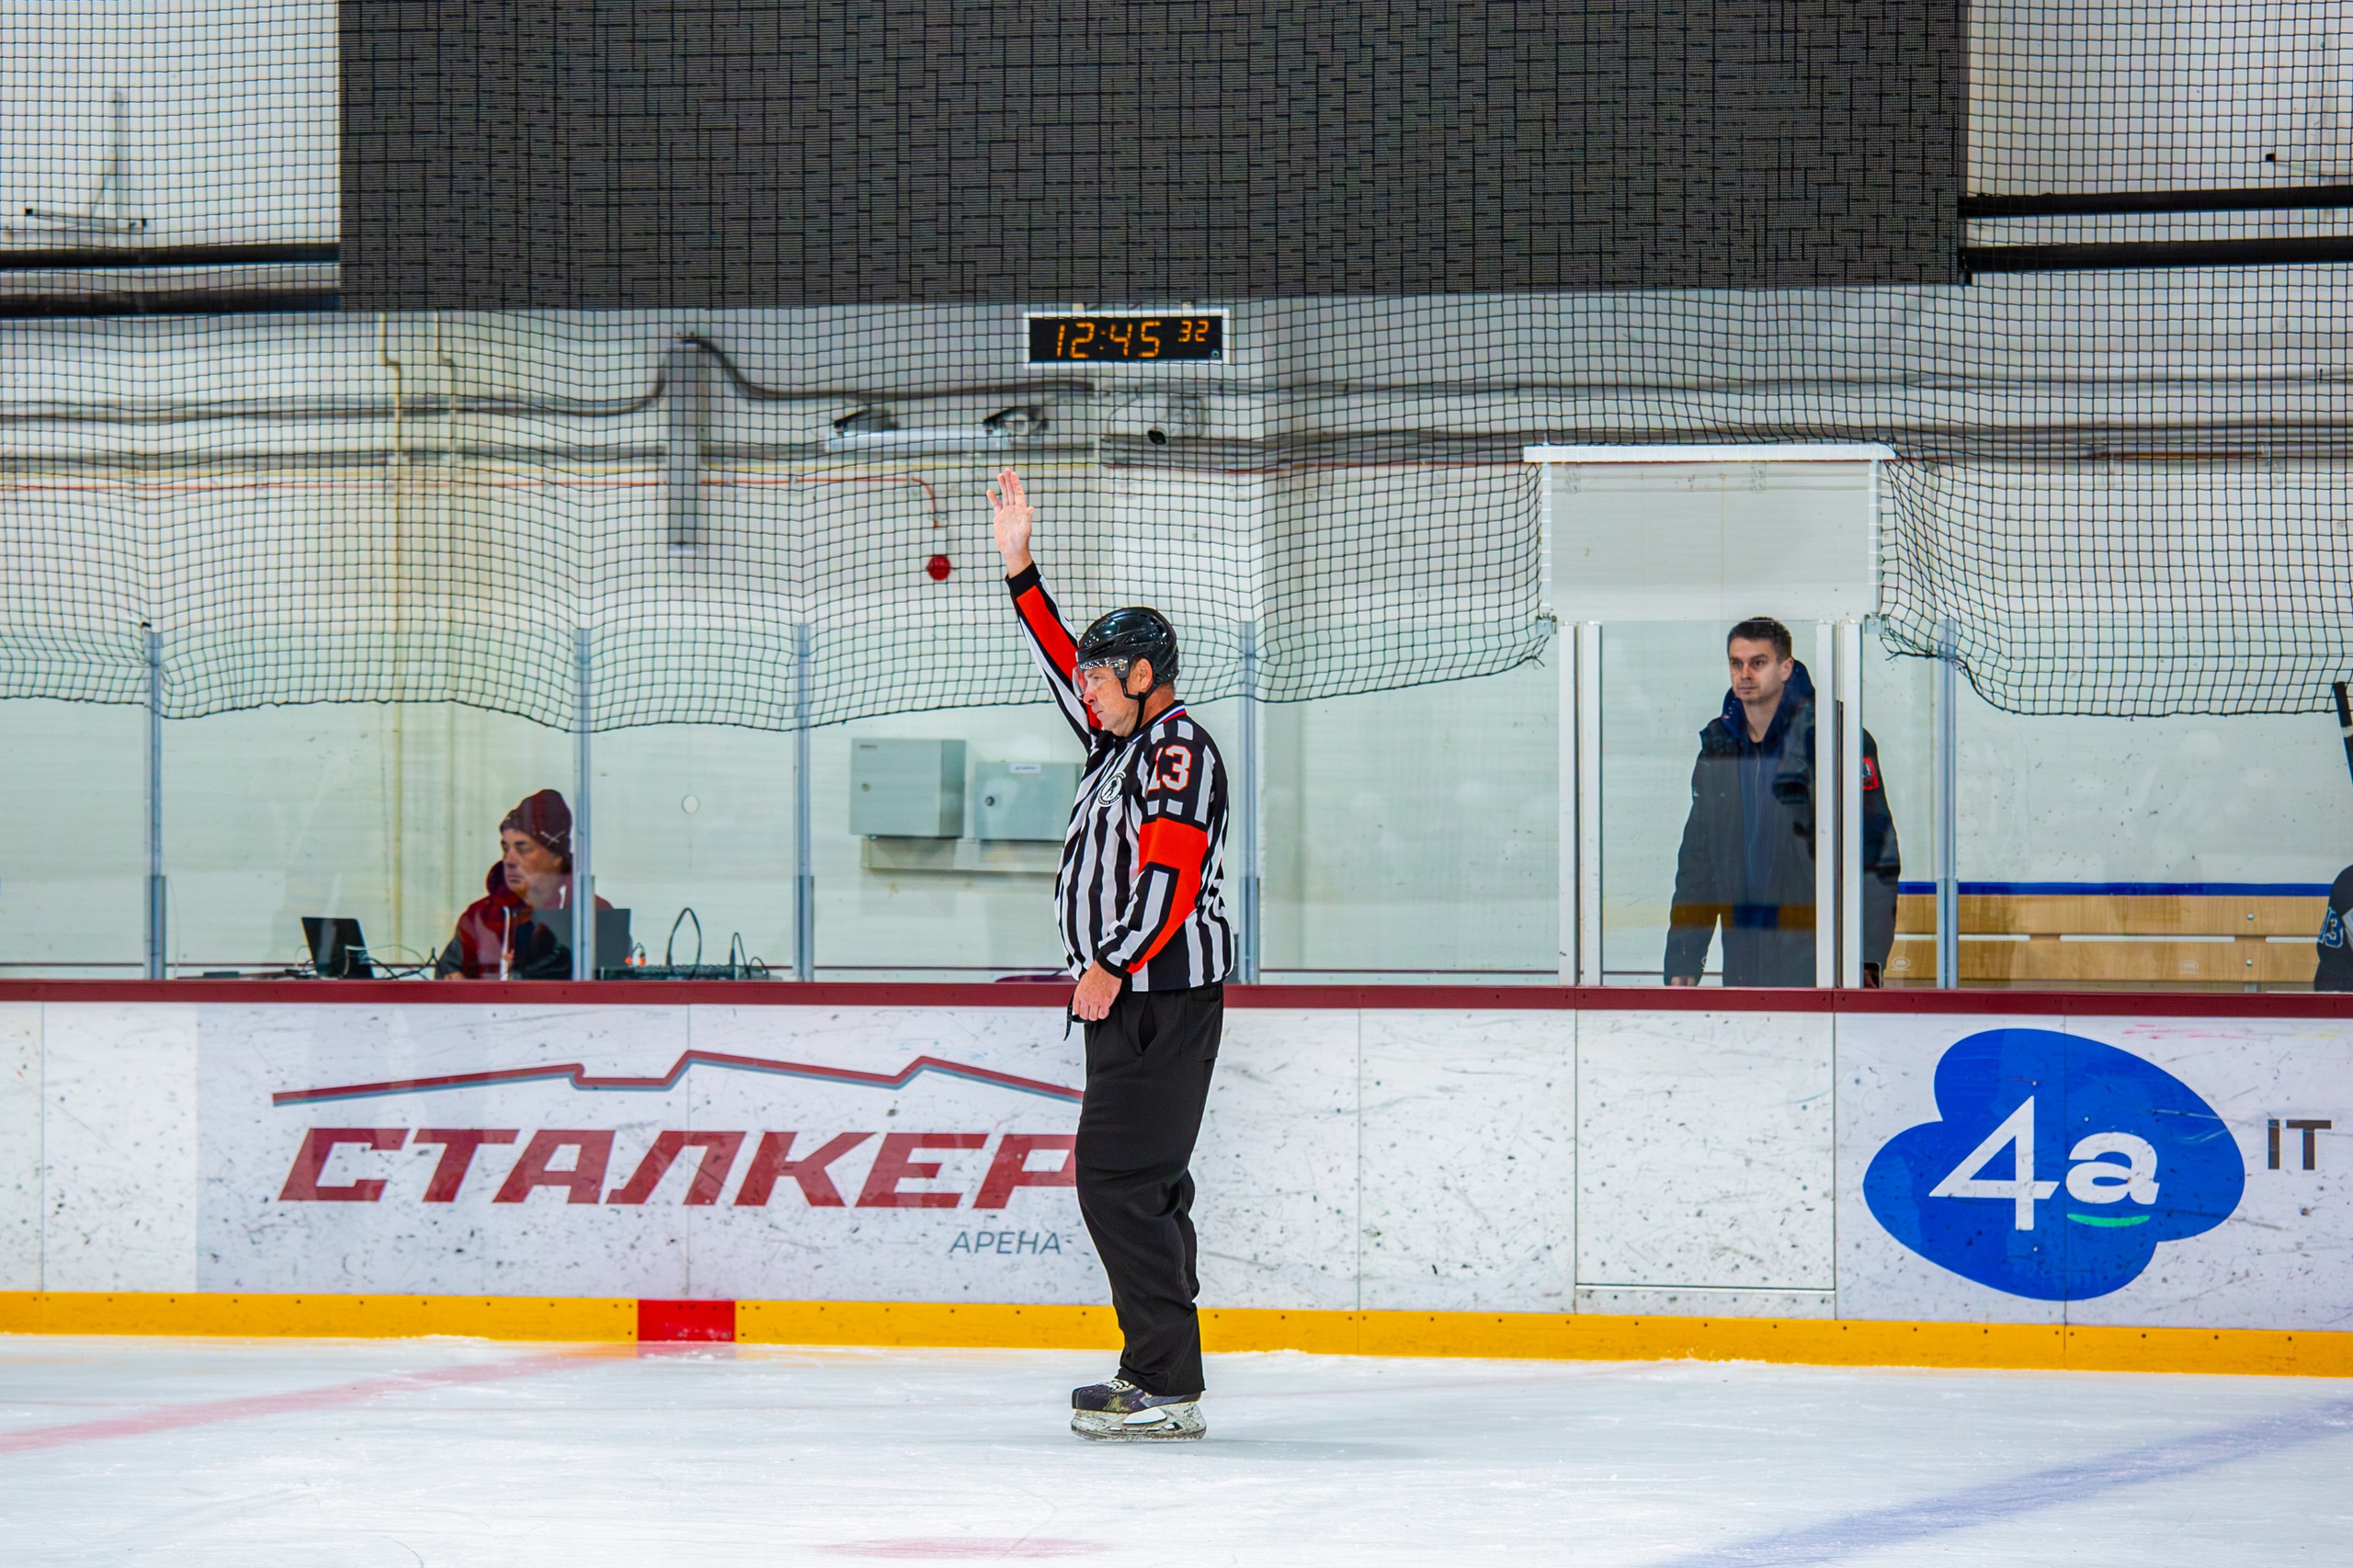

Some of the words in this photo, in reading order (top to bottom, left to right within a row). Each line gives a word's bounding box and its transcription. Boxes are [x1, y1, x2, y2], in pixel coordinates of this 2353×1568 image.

[1057, 321, 1162, 358] 12:45
[1177, 320, 1210, 342] 32
[1147, 744, 1193, 791] 13
[278, 1128, 1077, 1209] СТАЛКЕР
[1928, 1096, 2160, 1231] 4a
[2268, 1119, 2332, 1170] IT
[949, 1231, 1062, 1256] АРЕНА
